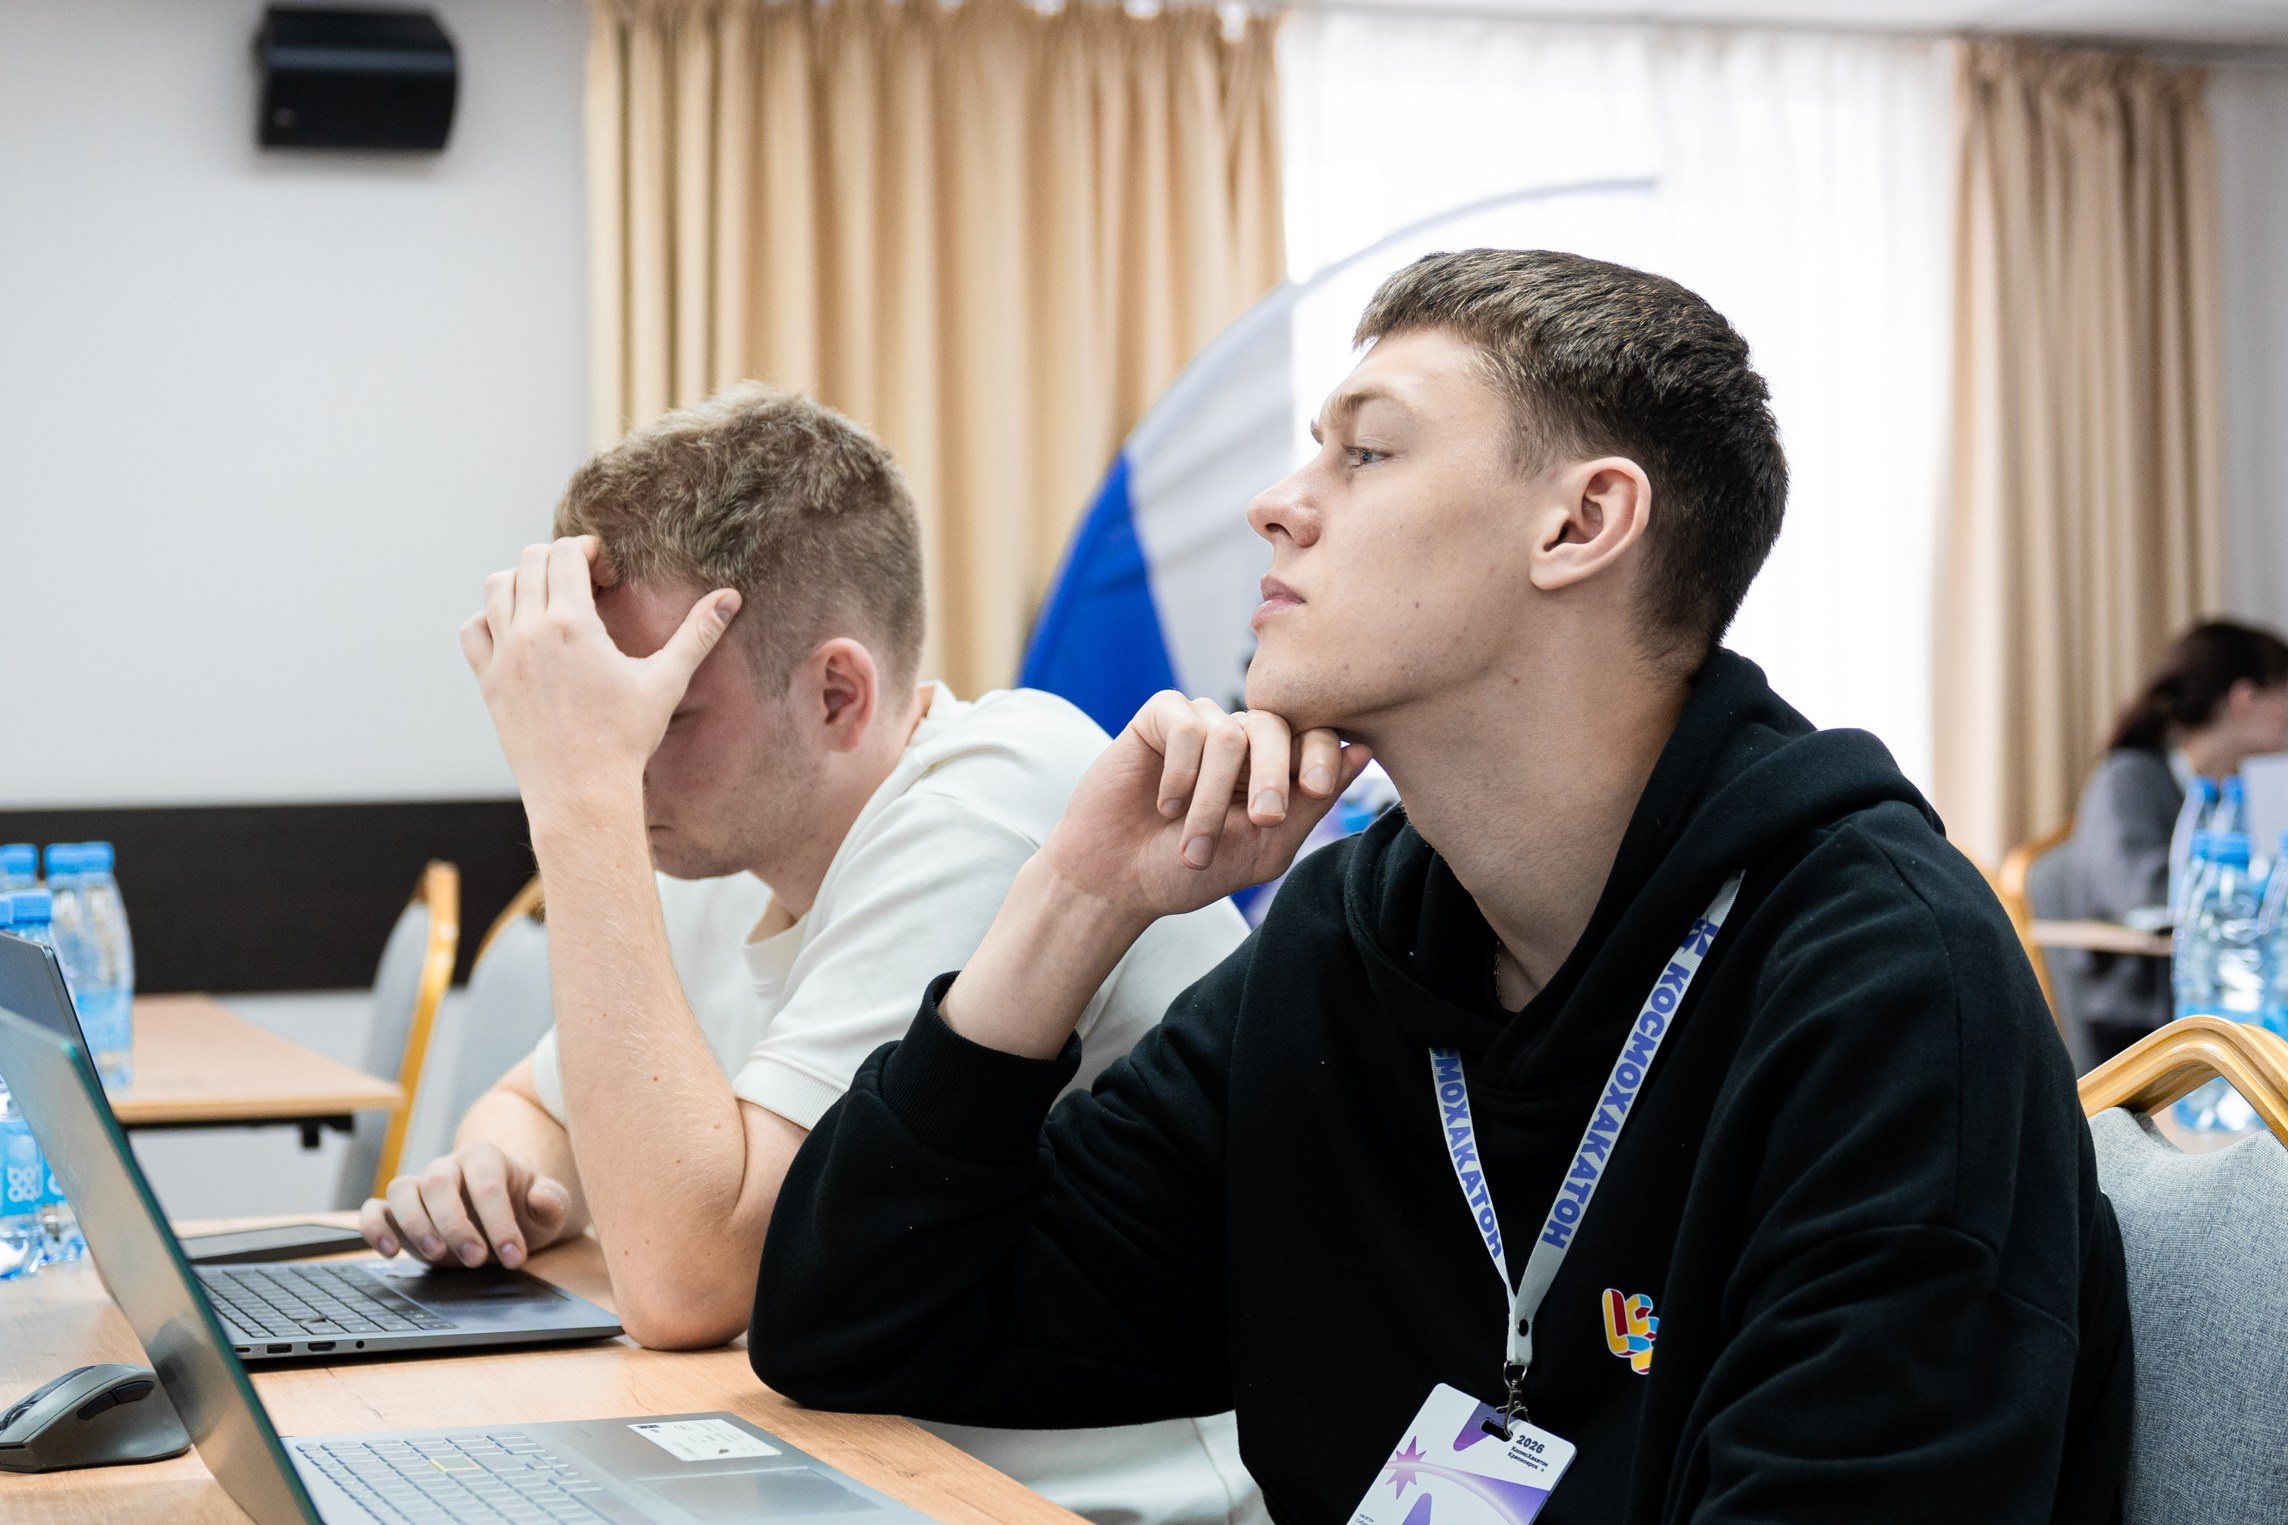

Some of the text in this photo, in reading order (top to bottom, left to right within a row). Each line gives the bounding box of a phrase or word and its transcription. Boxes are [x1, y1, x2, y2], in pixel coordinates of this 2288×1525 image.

[1541, 961, 1691, 1250] КОСМОХАКАТОН
[1515, 1434, 1546, 1454] 2026
[1507, 1451, 1539, 1470] Красноярск
[1510, 1445, 1549, 1468] КосмоХакатон
